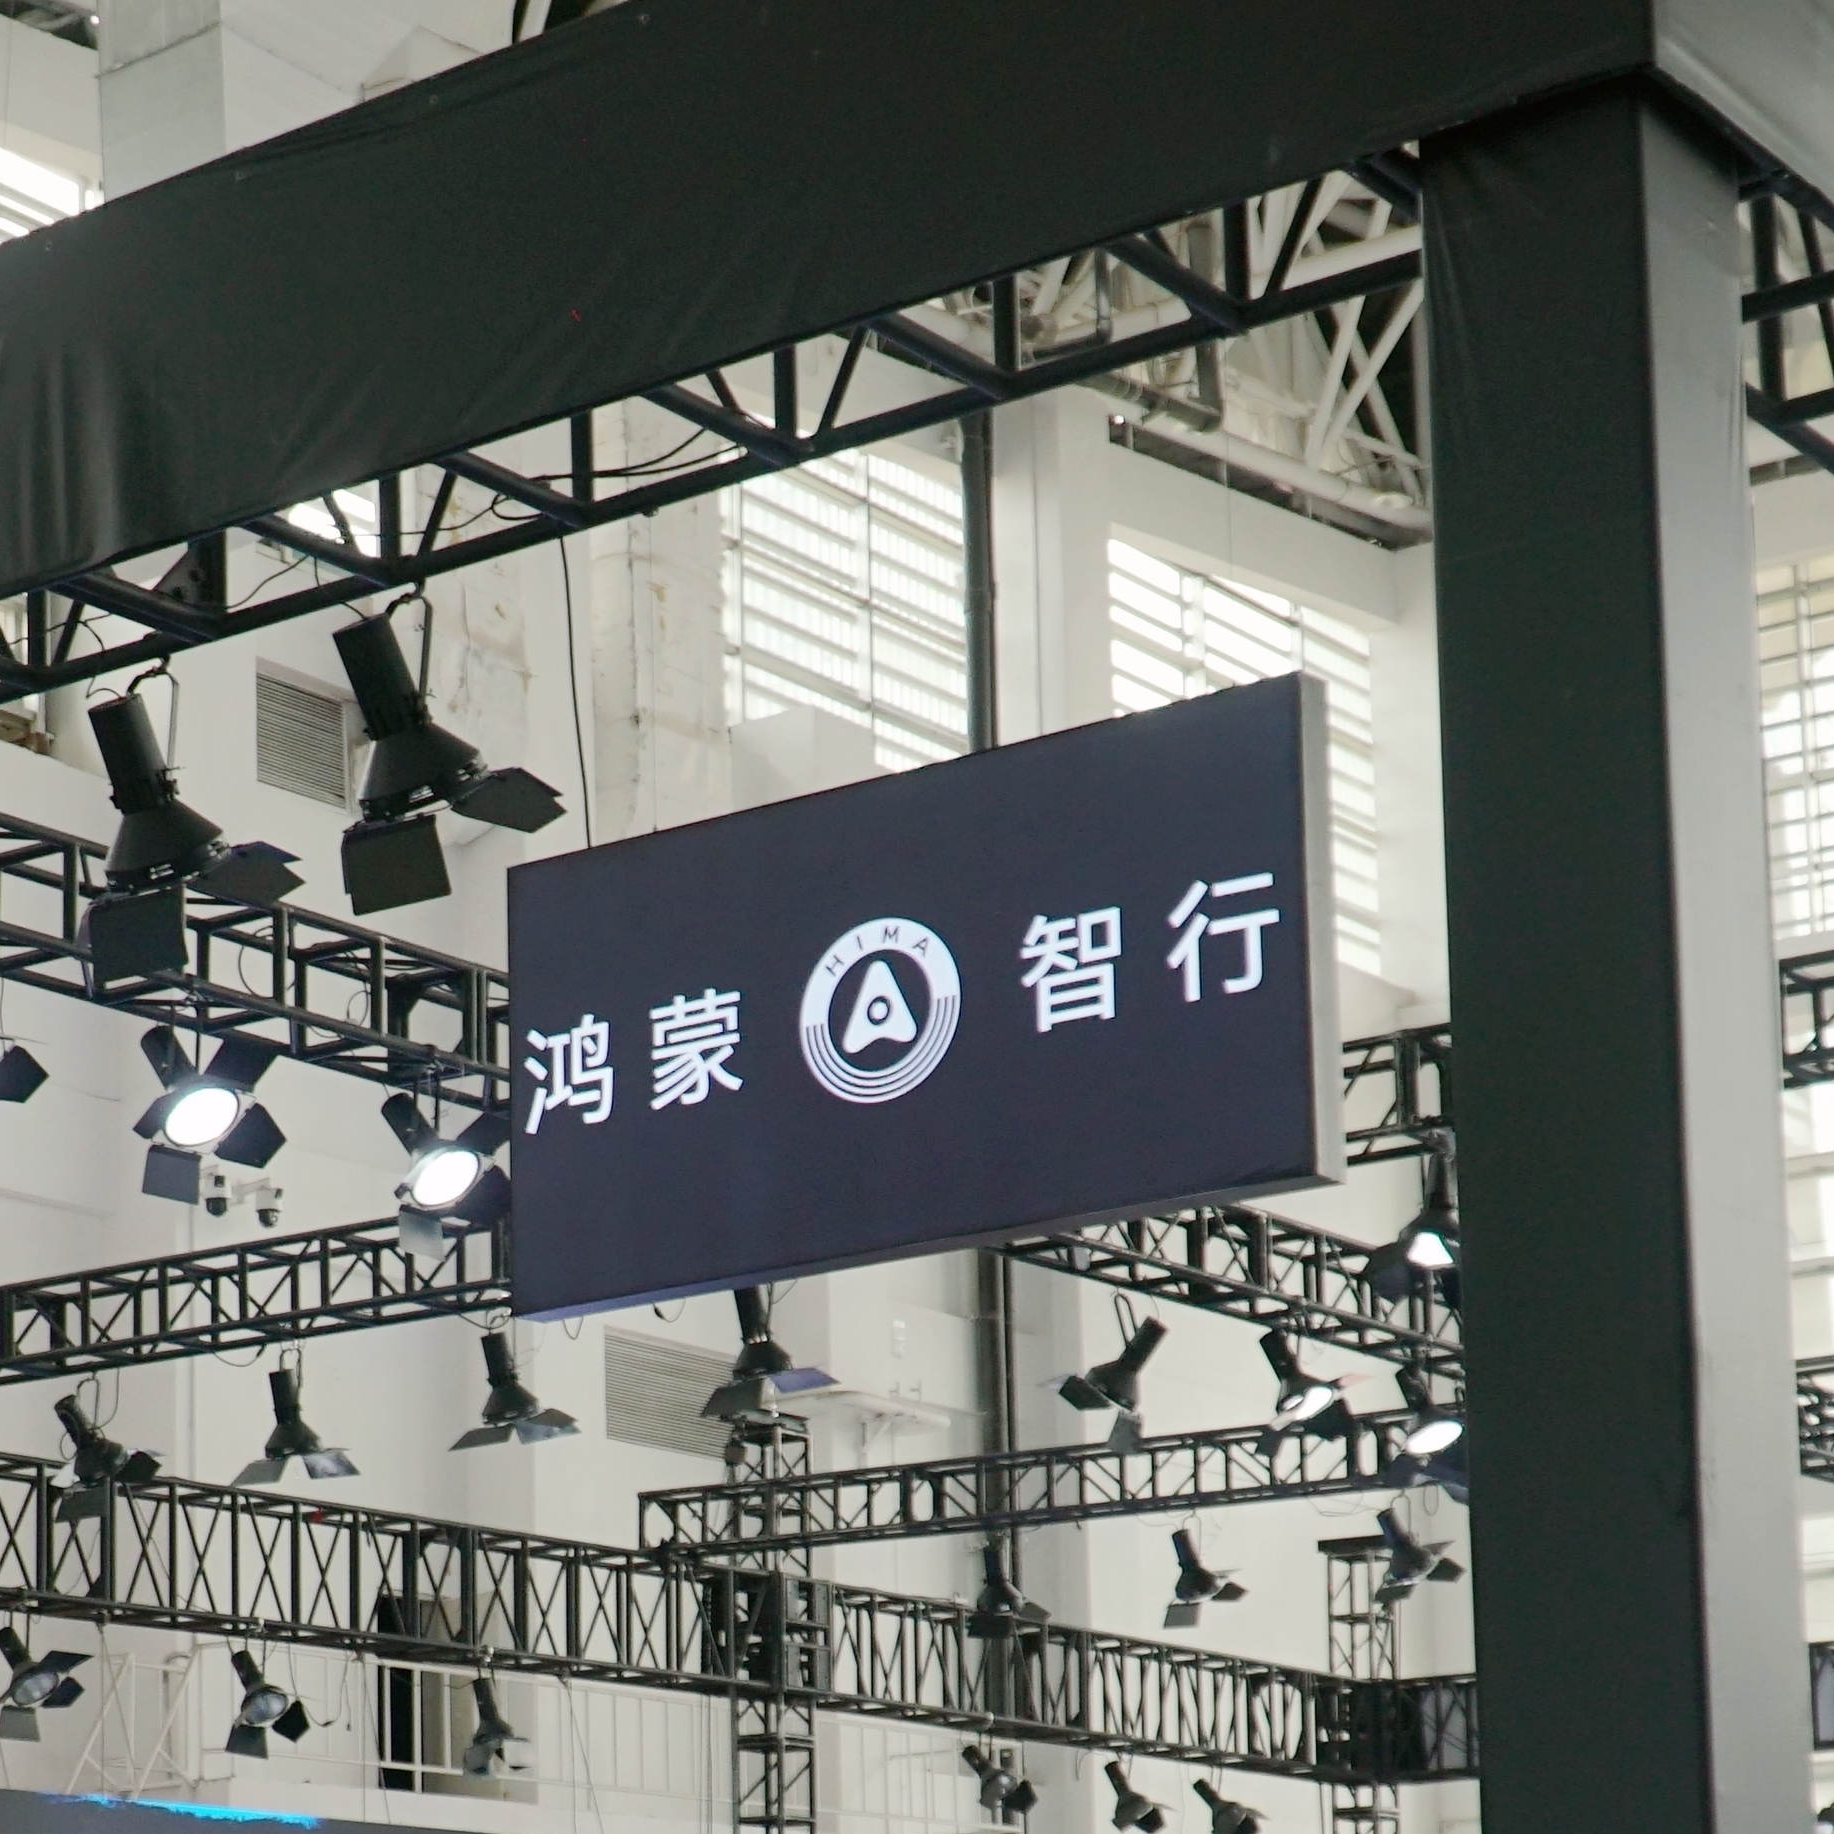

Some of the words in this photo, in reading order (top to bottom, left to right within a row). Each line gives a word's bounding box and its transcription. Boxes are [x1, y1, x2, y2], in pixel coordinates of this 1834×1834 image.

[523, 987, 744, 1136] 鸿蒙
[1019, 872, 1281, 1034] 智行
[824, 925, 932, 978] HIMA
